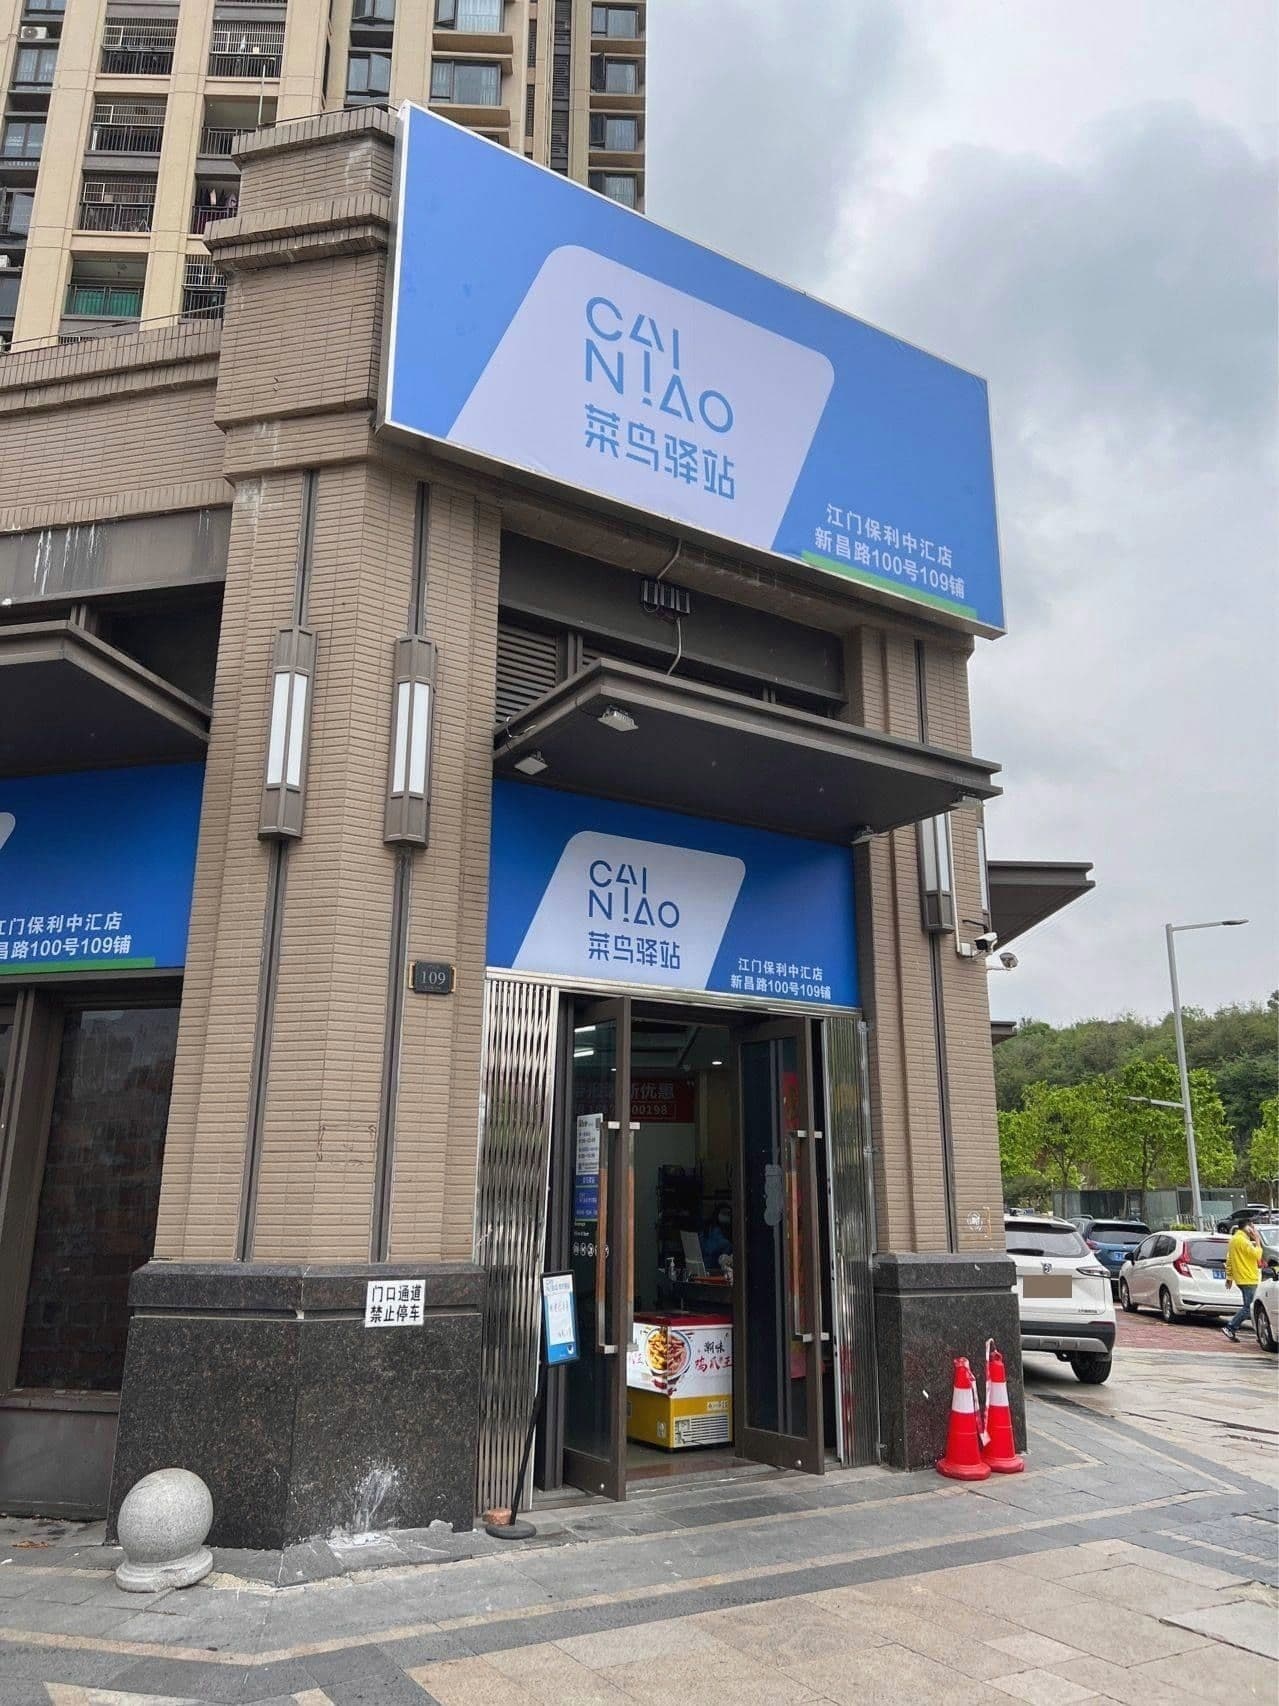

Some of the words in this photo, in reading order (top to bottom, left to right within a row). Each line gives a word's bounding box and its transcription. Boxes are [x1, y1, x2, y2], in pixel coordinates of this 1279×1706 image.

[586, 296, 680, 370] CAI
[584, 403, 735, 500] 菜鸟驿站
[826, 503, 953, 569] 江门保利中汇店
[814, 526, 965, 600] 新昌路100号109铺
[589, 860, 647, 895] CAI
[588, 931, 681, 970] 菜鸟驿站
[421, 971, 446, 985] 109
[730, 974, 832, 1000] 新昌路100号109铺
[738, 958, 823, 982] 江门保利中汇店
[371, 1283, 422, 1303] 门口通道
[370, 1304, 421, 1324] 禁止停车
